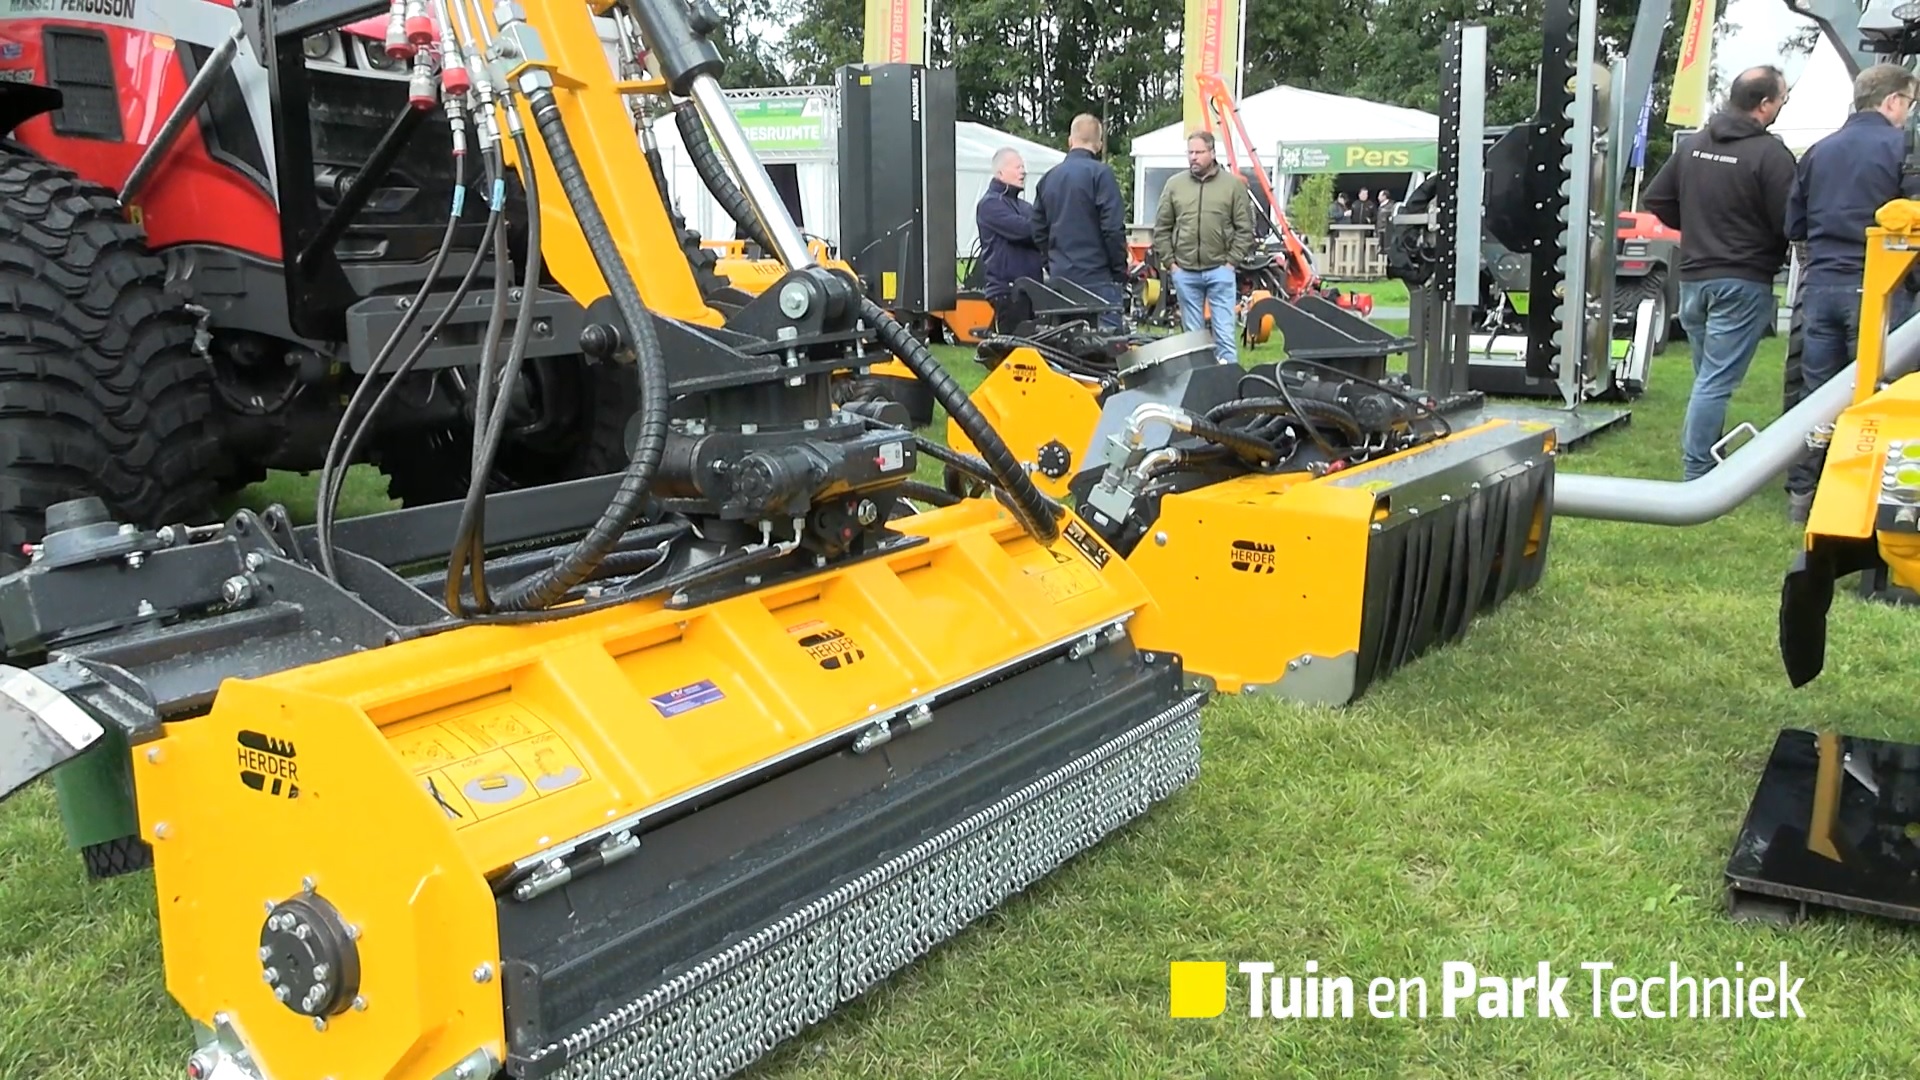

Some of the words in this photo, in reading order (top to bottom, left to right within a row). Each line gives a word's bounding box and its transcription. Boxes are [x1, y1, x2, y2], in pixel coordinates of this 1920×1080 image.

[1346, 146, 1409, 167] Pers
[1230, 549, 1275, 565] HERDER
[805, 636, 858, 660] HERDER
[237, 747, 299, 782] HERDER
